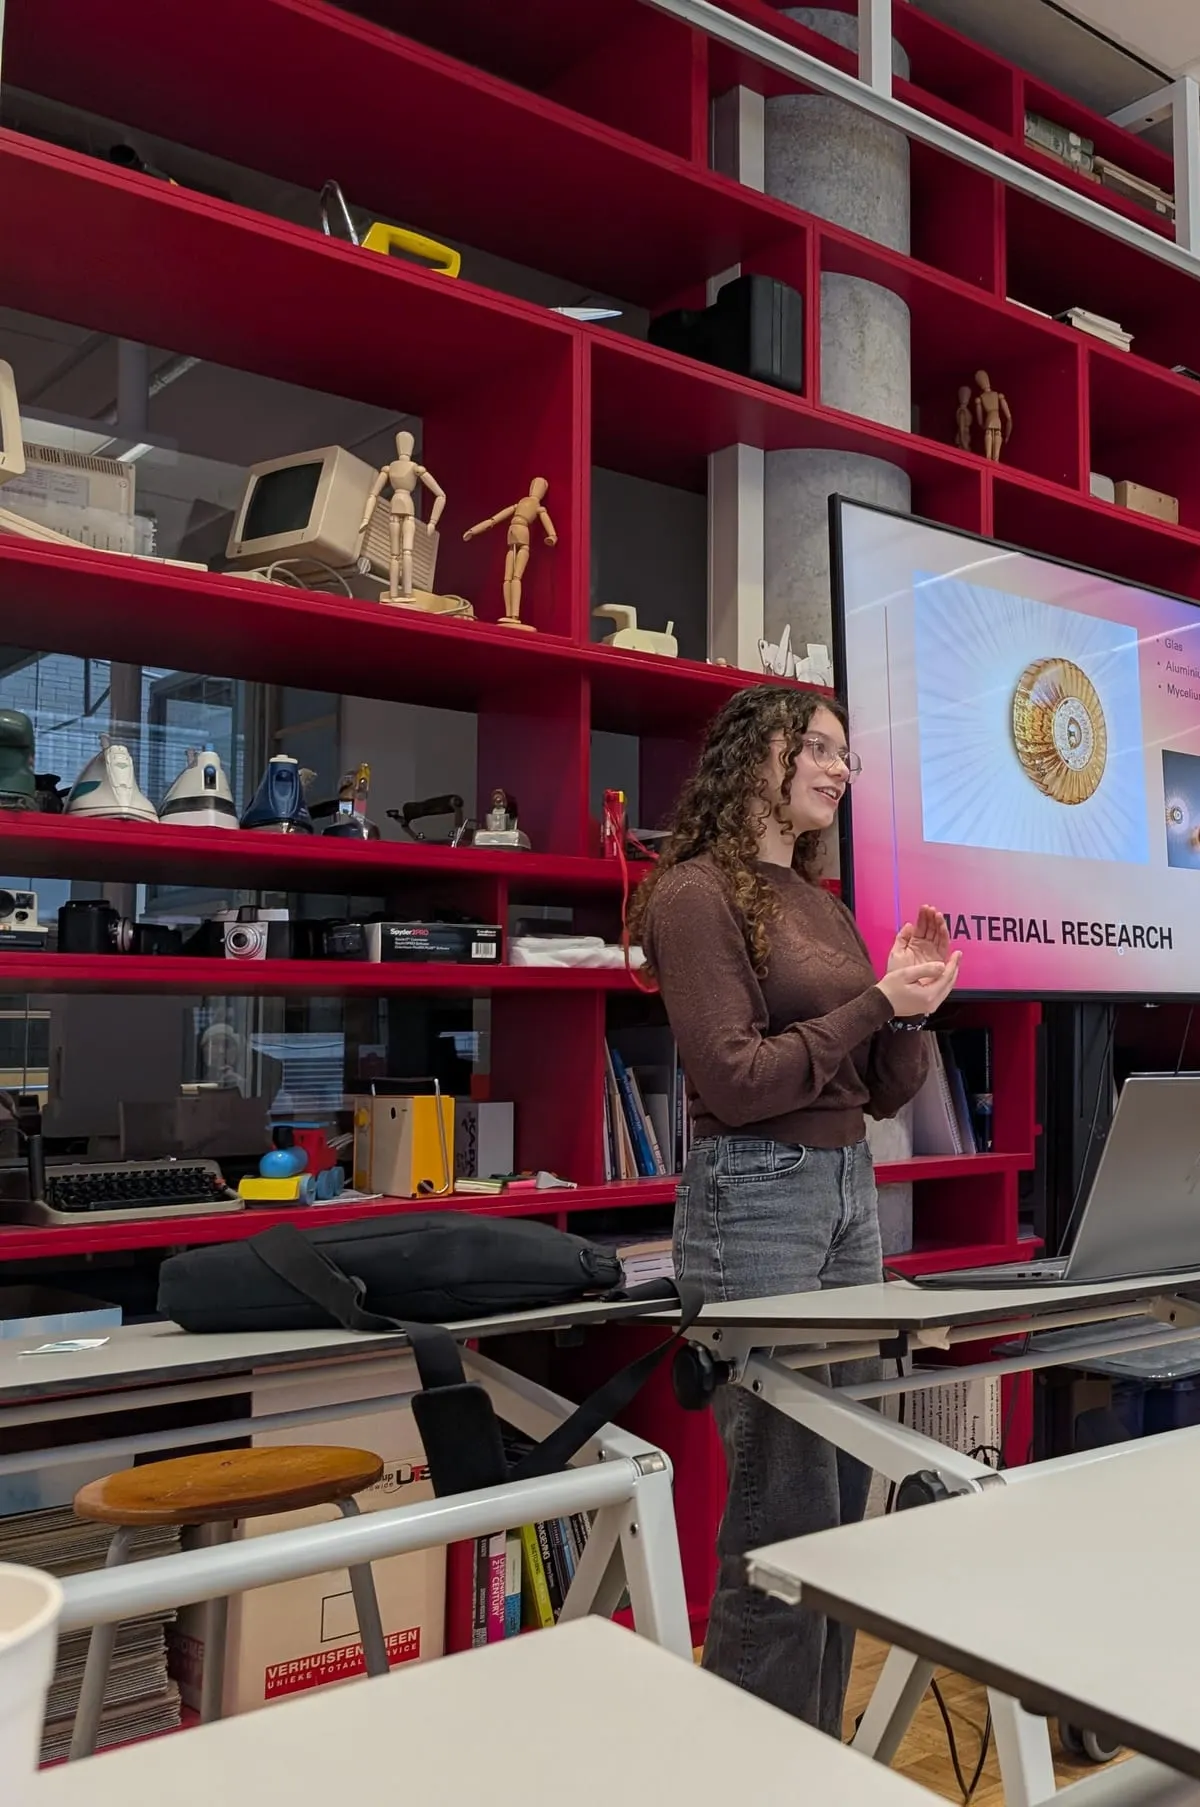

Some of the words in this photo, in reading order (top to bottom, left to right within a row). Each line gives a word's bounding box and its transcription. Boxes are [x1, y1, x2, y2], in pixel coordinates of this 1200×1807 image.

[1164, 638, 1183, 652] Glas
[1061, 920, 1174, 950] RESEARCH
[491, 1576, 499, 1616] CENTURY
[267, 1630, 418, 1679] VERHUISFENEEN
[267, 1672, 313, 1690] UNIEKE
[320, 1658, 363, 1675] TOTAAL
[386, 1643, 418, 1657] VICE
